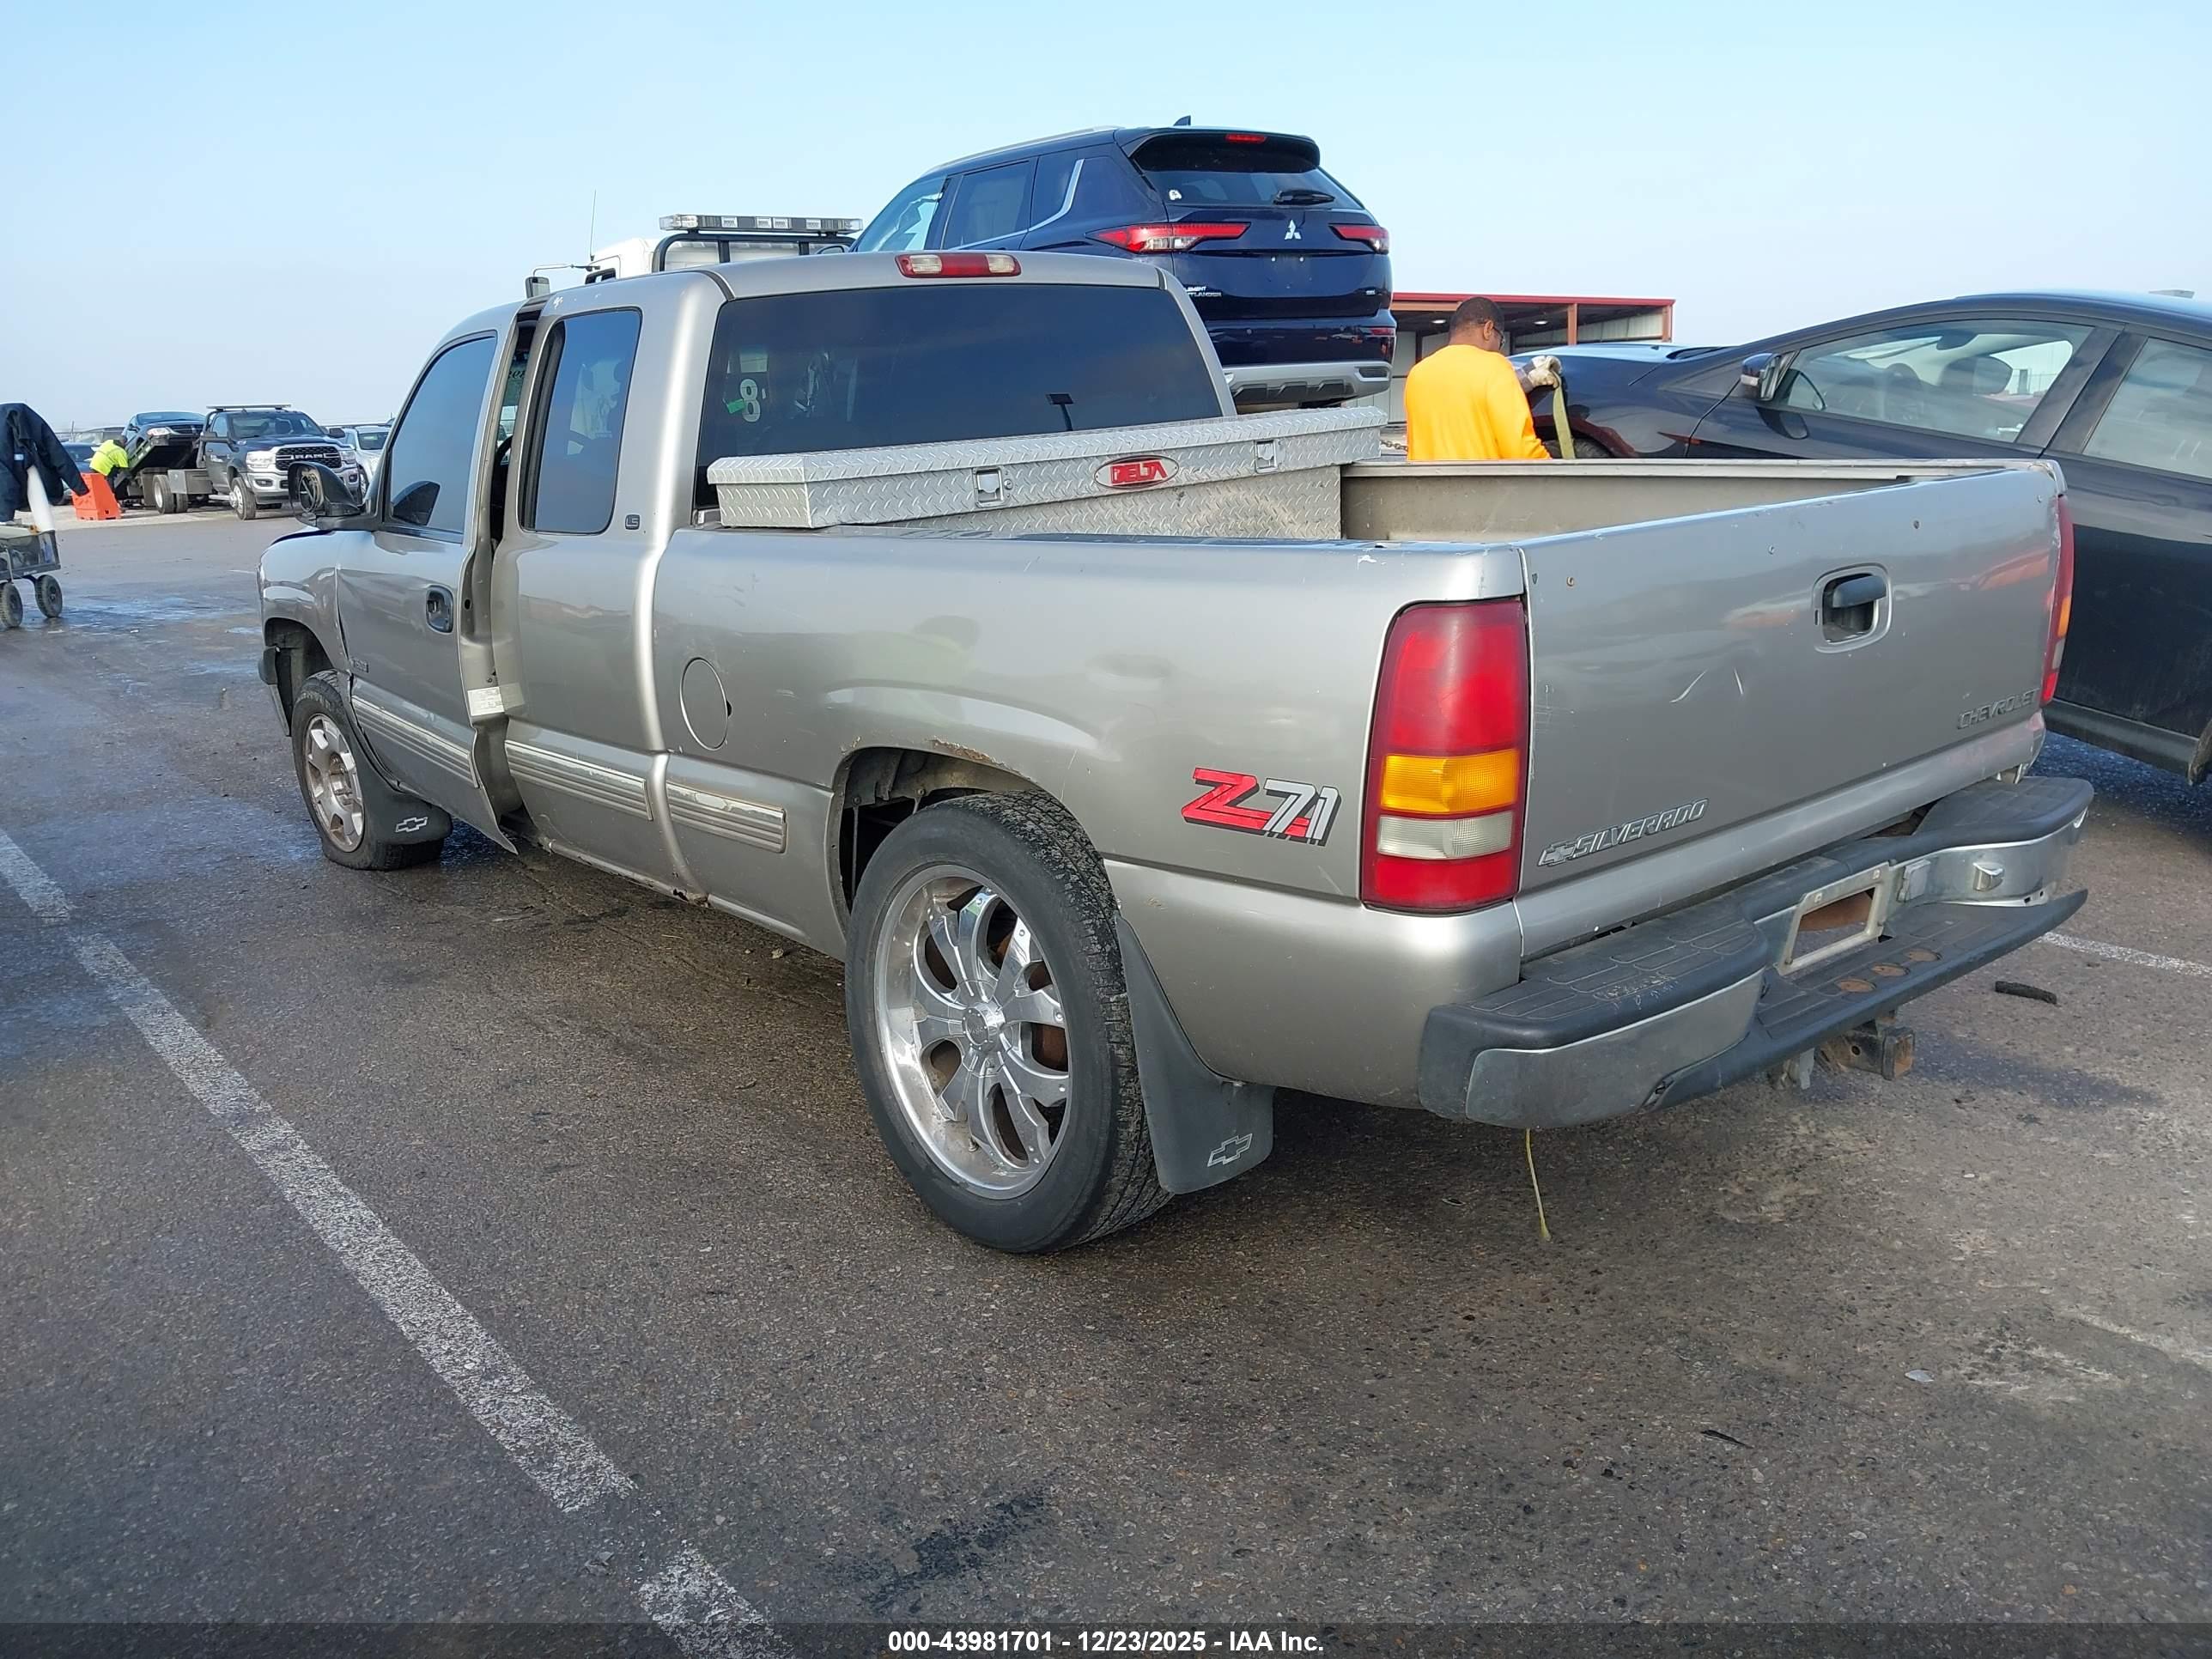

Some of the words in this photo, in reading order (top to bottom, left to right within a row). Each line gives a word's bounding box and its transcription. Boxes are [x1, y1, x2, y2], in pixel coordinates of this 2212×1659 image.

[1109, 459, 1169, 486] DELTA
[626, 516, 639, 527] LS
[1958, 687, 2040, 729] CHEVROLET
[1182, 768, 1341, 847] Z71
[1572, 798, 1709, 859] SILVERADO
